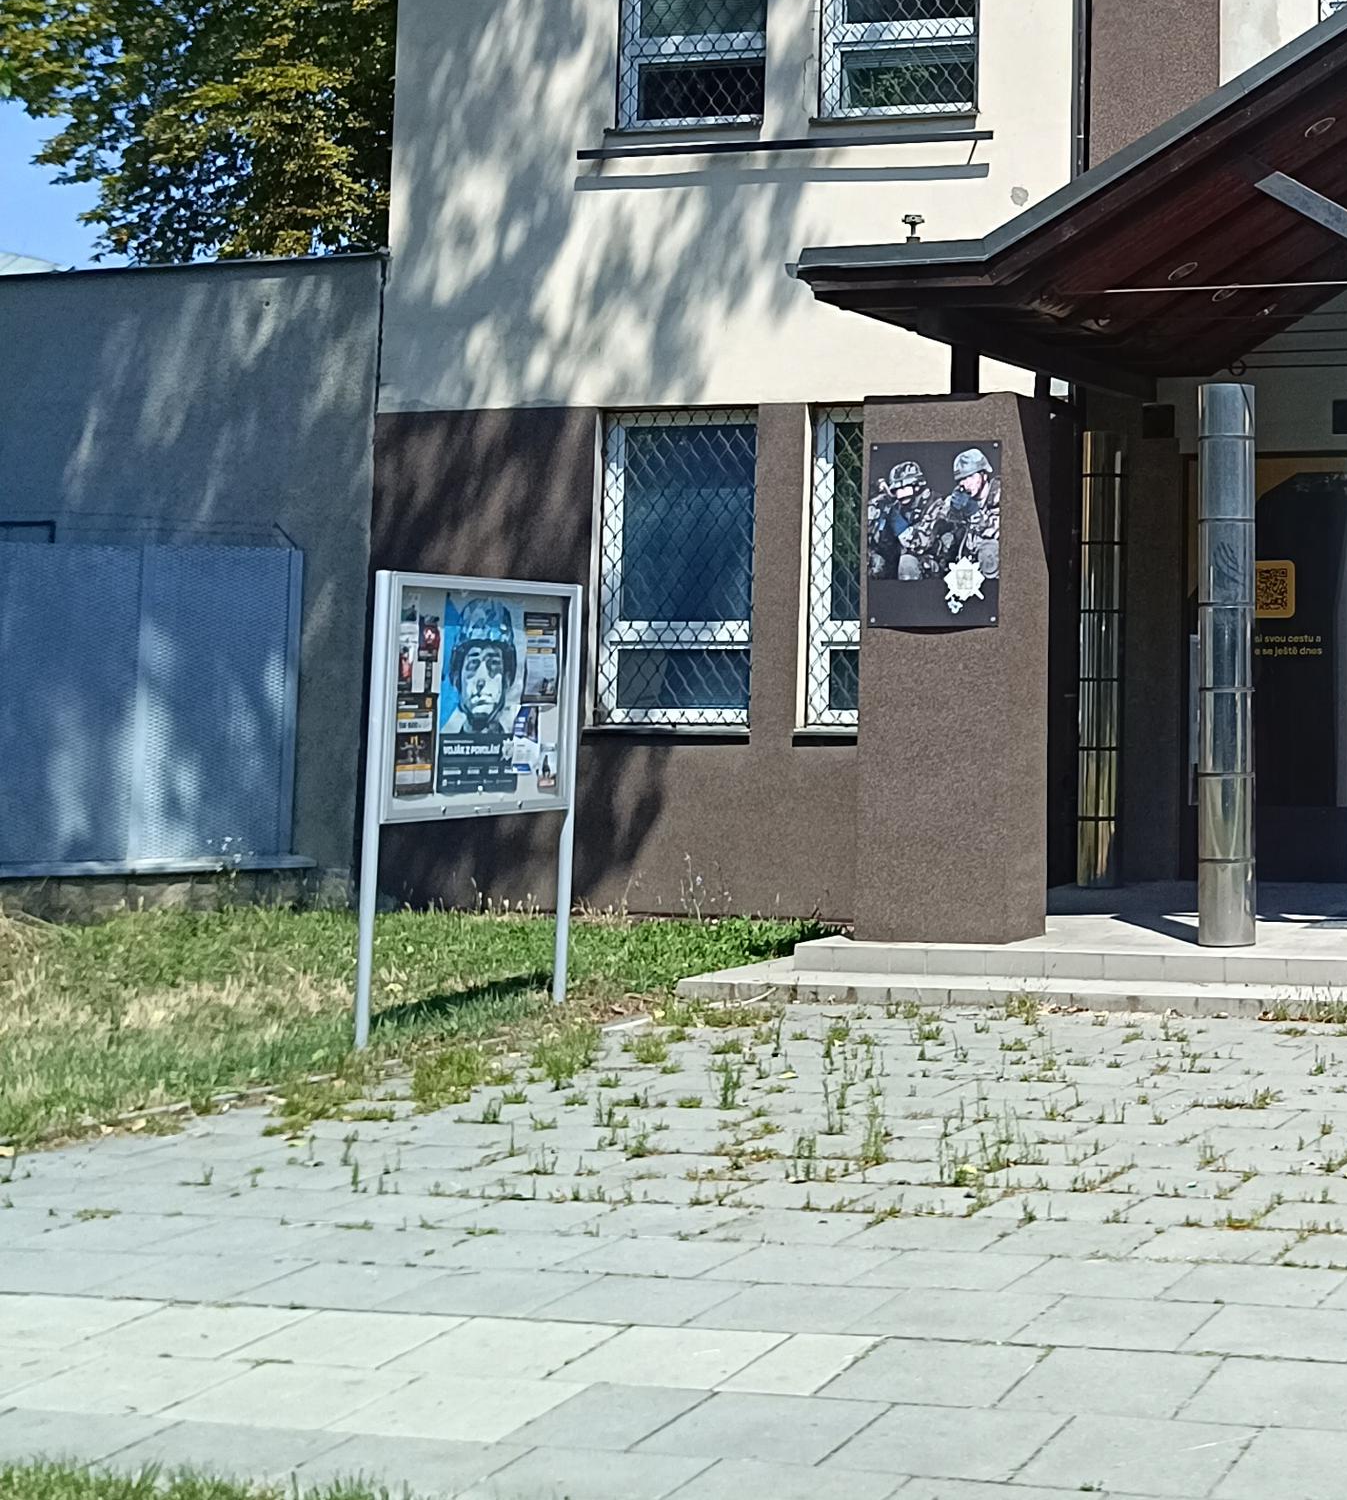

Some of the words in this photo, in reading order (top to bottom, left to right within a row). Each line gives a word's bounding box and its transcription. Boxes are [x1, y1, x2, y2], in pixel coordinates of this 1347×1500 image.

[1264, 635, 1287, 643] svou
[1287, 634, 1315, 643] cestu
[1299, 646, 1323, 656] dnes
